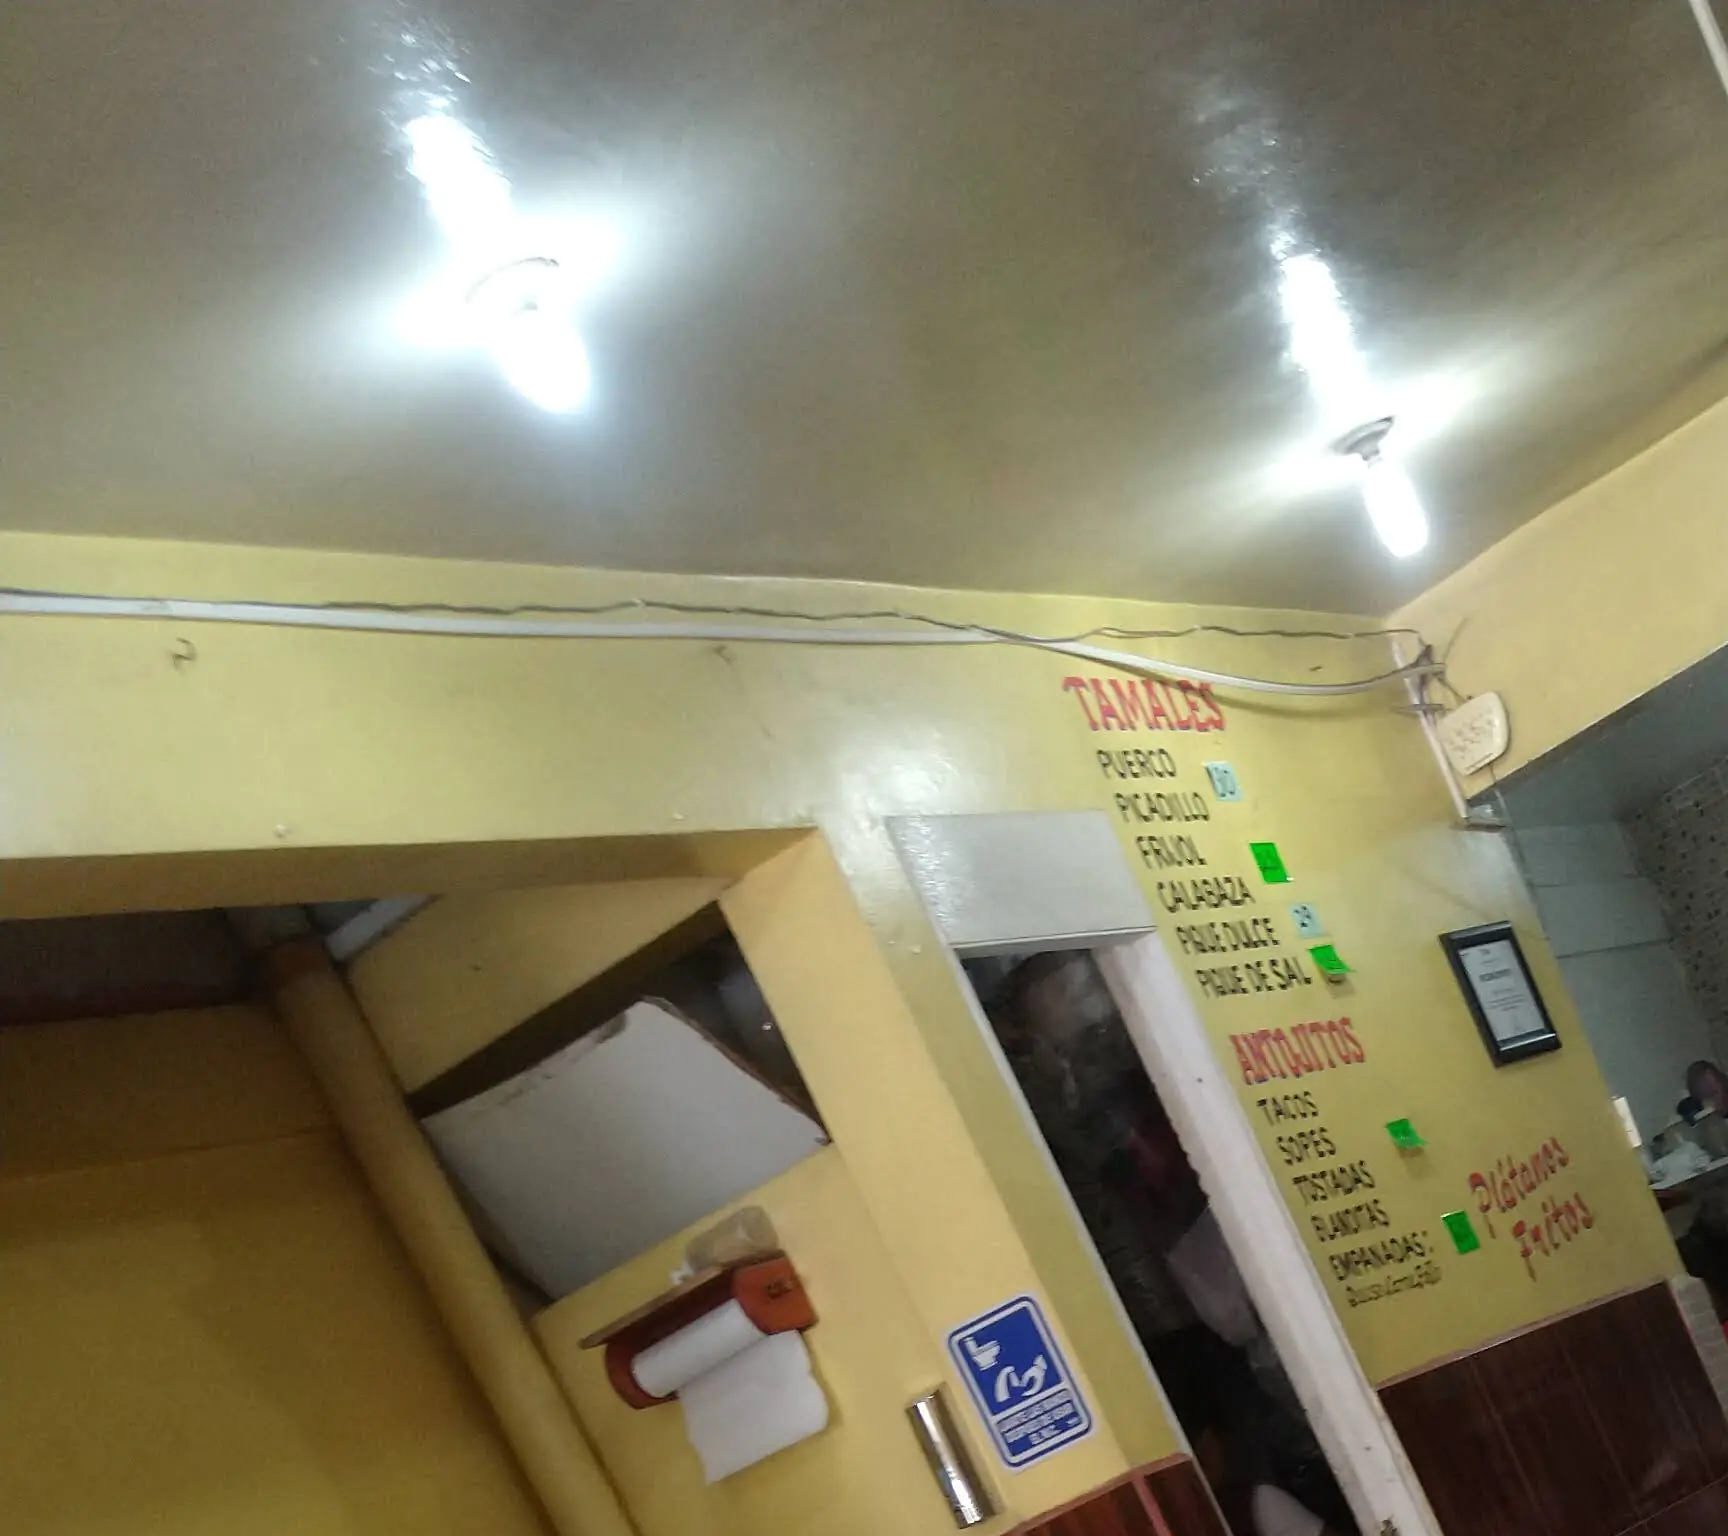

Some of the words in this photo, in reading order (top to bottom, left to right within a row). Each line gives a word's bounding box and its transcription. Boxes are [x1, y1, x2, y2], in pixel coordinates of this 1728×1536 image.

[1062, 676, 1226, 732] TAMALES
[1096, 748, 1176, 779] PUERCO
[1114, 792, 1210, 823] PICADILLO
[1136, 836, 1208, 869] FRIJOL
[1157, 876, 1255, 913] CALABAZA
[1244, 960, 1274, 992] DE
[1268, 956, 1312, 991] SAL
[1228, 1016, 1366, 1085] ANTOJITOS
[1256, 1090, 1319, 1126] TACOS
[1277, 1127, 1336, 1166] SOPES
[1292, 1160, 1376, 1207] TOSTADAS
